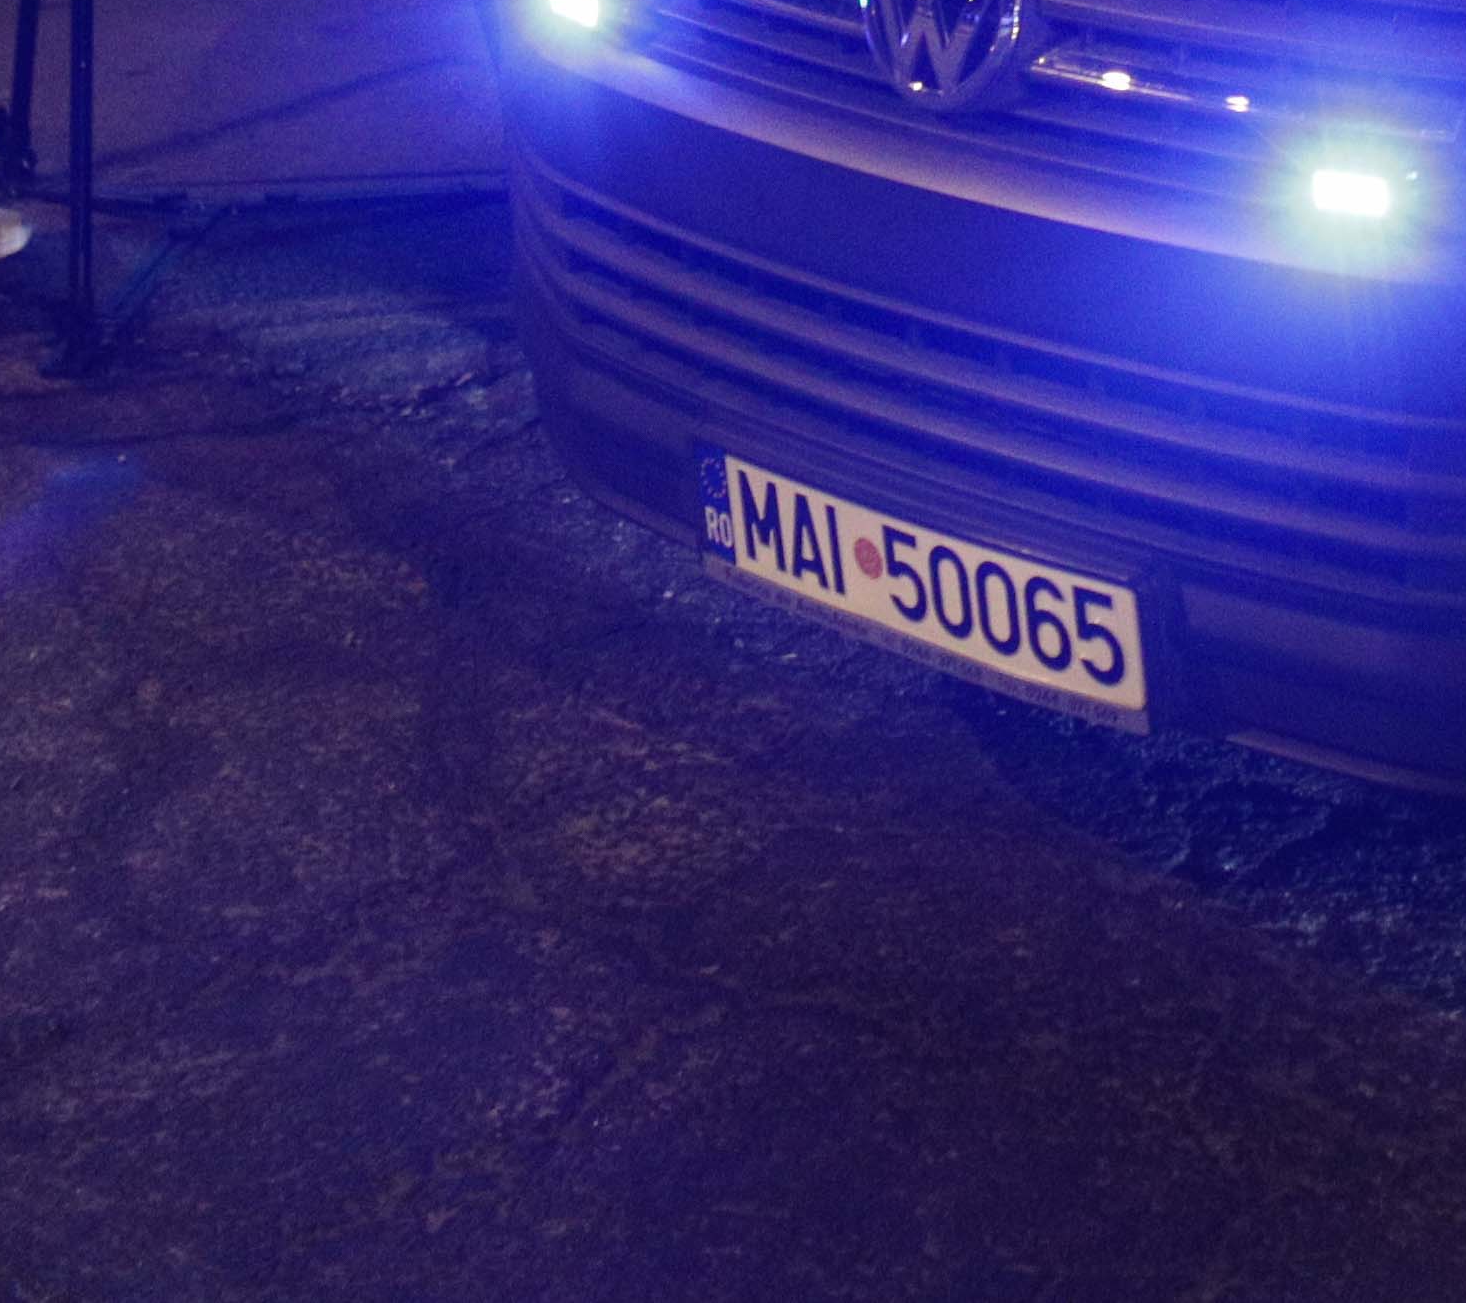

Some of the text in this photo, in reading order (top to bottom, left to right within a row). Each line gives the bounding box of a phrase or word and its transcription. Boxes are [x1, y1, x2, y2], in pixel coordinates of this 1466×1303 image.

[704, 505, 732, 549] RO
[738, 469, 847, 596] MAI
[881, 524, 1125, 686] 50065
